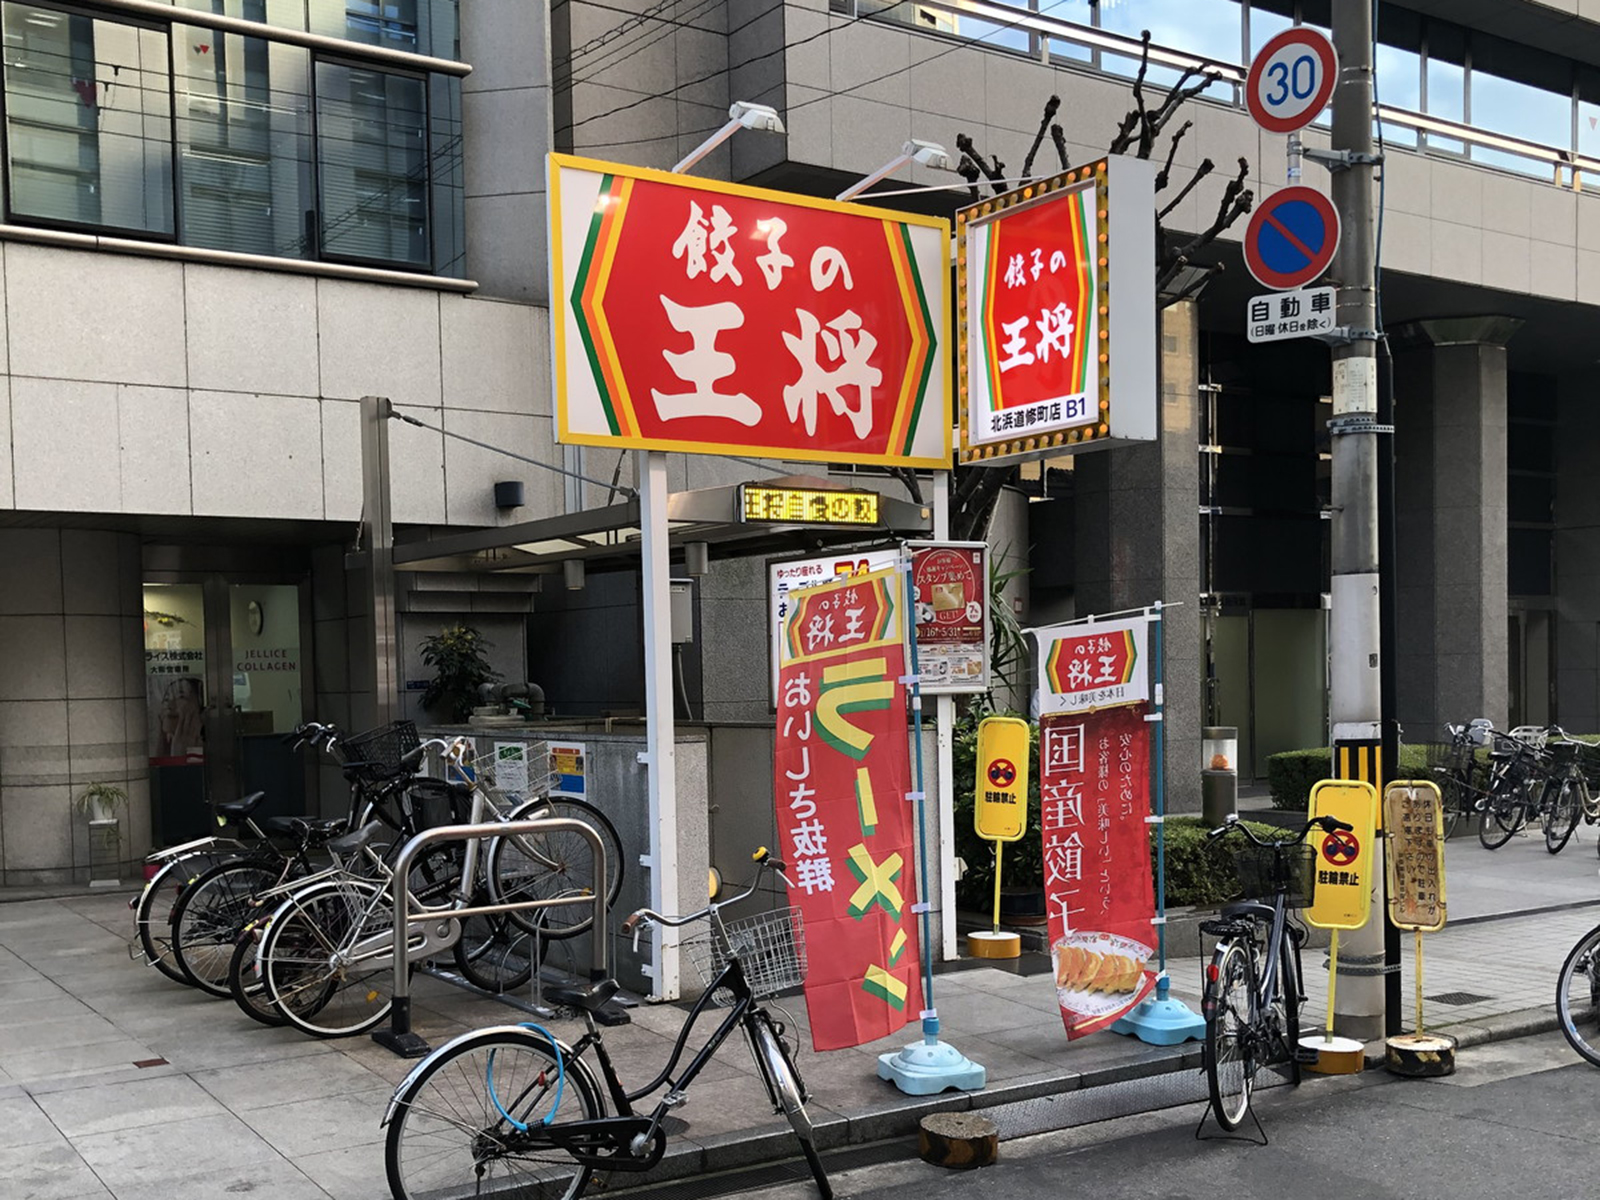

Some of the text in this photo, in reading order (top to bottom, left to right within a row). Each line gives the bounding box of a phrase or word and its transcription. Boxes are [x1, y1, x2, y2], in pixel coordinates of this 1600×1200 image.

[1266, 55, 1315, 106] 30
[672, 200, 854, 291] 餃子の
[1004, 248, 1067, 290] 餃子の
[1252, 293, 1331, 322] 自動車
[998, 302, 1074, 373] 王将
[650, 294, 883, 440] 王将
[991, 397, 1085, 432] 北浜道修町店 B1
[777, 565, 823, 579] ゆったり座れる
[237, 662, 296, 672] COLLAGEN
[245, 650, 287, 660] JELLICE
[985, 791, 1016, 804] 駐輪禁止
[1317, 870, 1359, 886] 駐輪禁止
